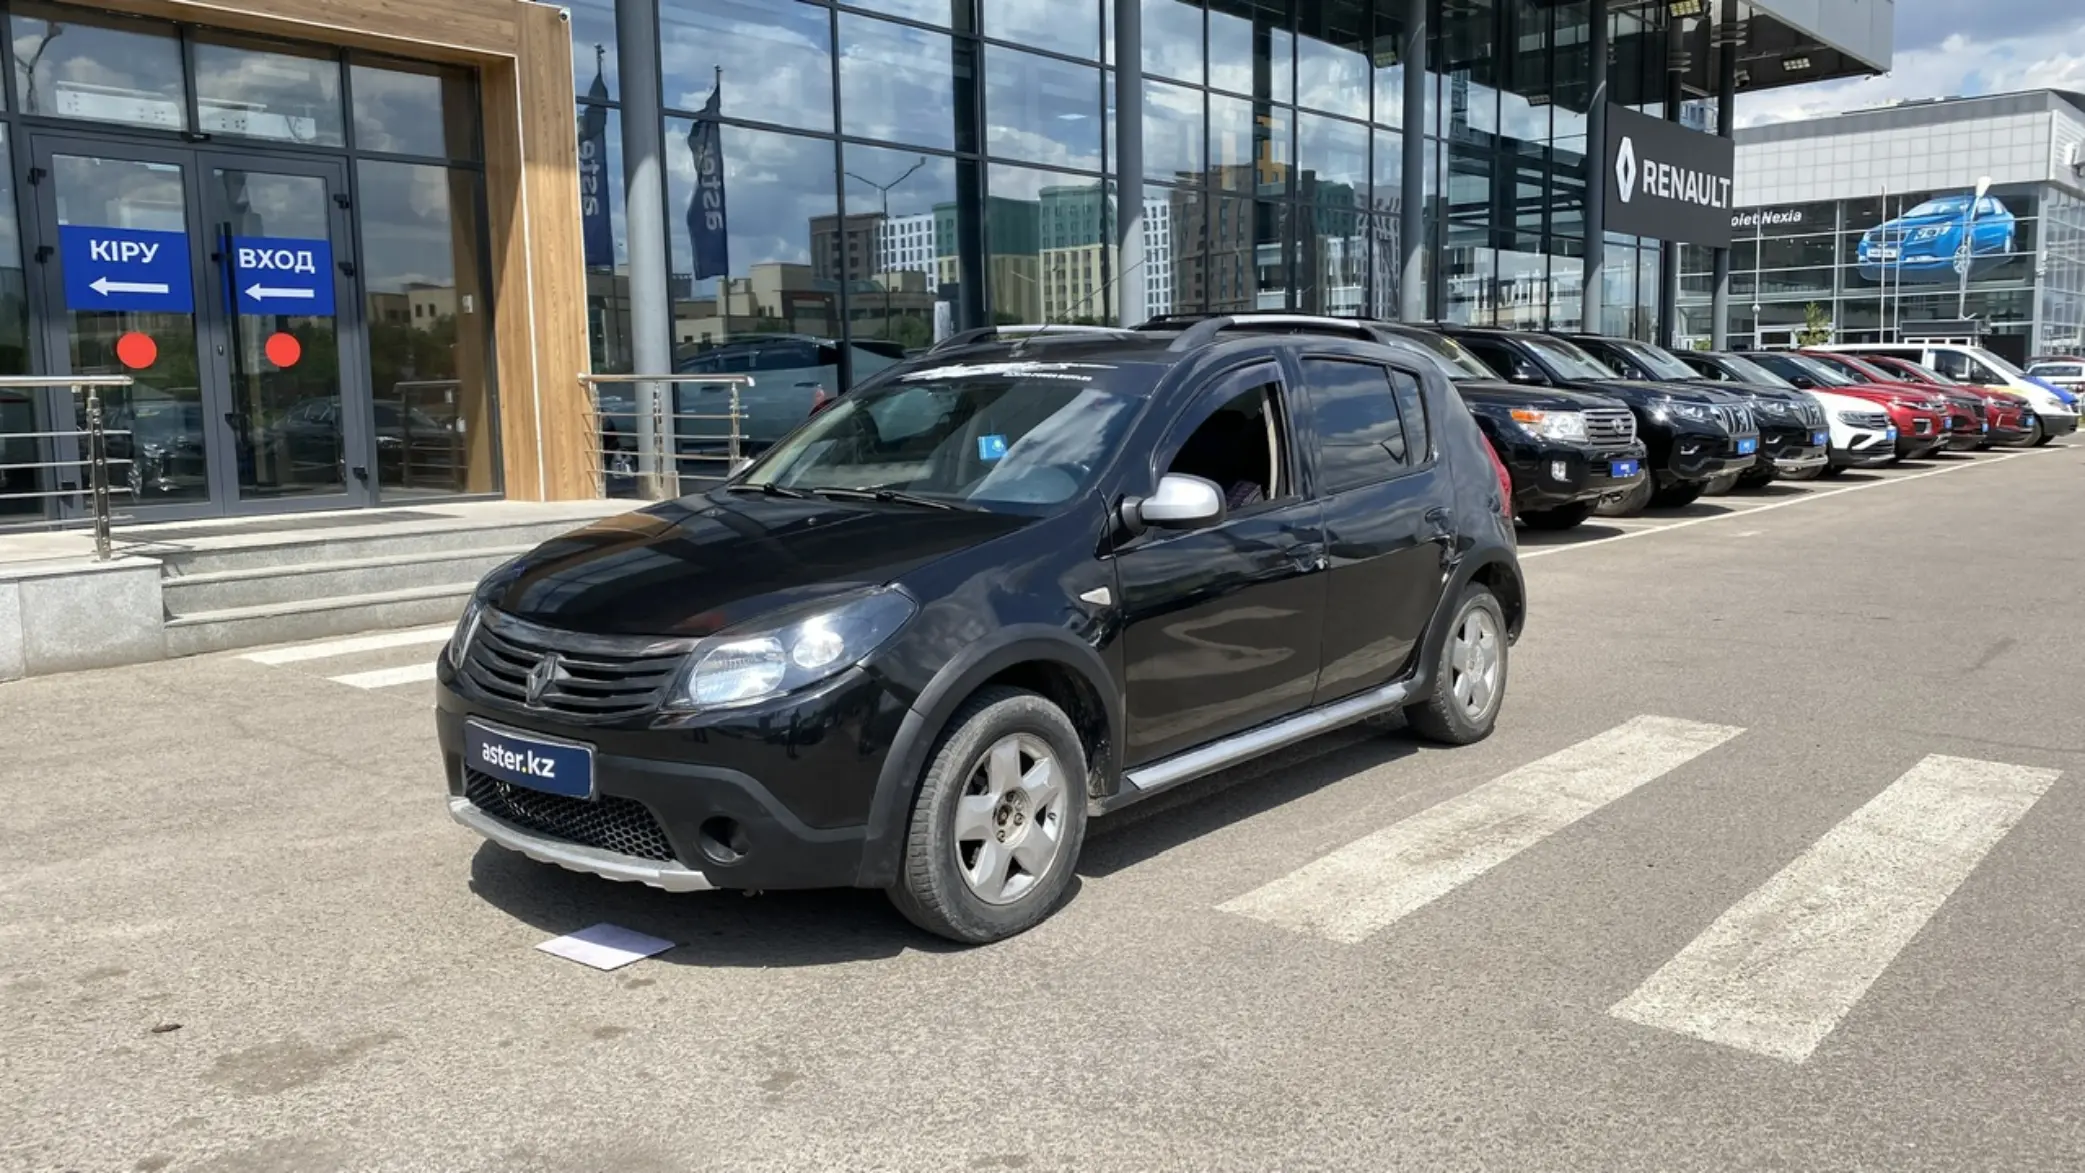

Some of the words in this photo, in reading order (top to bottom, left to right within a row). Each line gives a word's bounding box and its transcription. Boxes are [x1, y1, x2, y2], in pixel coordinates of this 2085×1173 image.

[1643, 159, 1731, 209] RENAULT
[1762, 209, 1802, 225] Nexia
[89, 239, 159, 264] КІРУ
[238, 248, 315, 274] ВХОД
[482, 742, 556, 779] aster.kz
